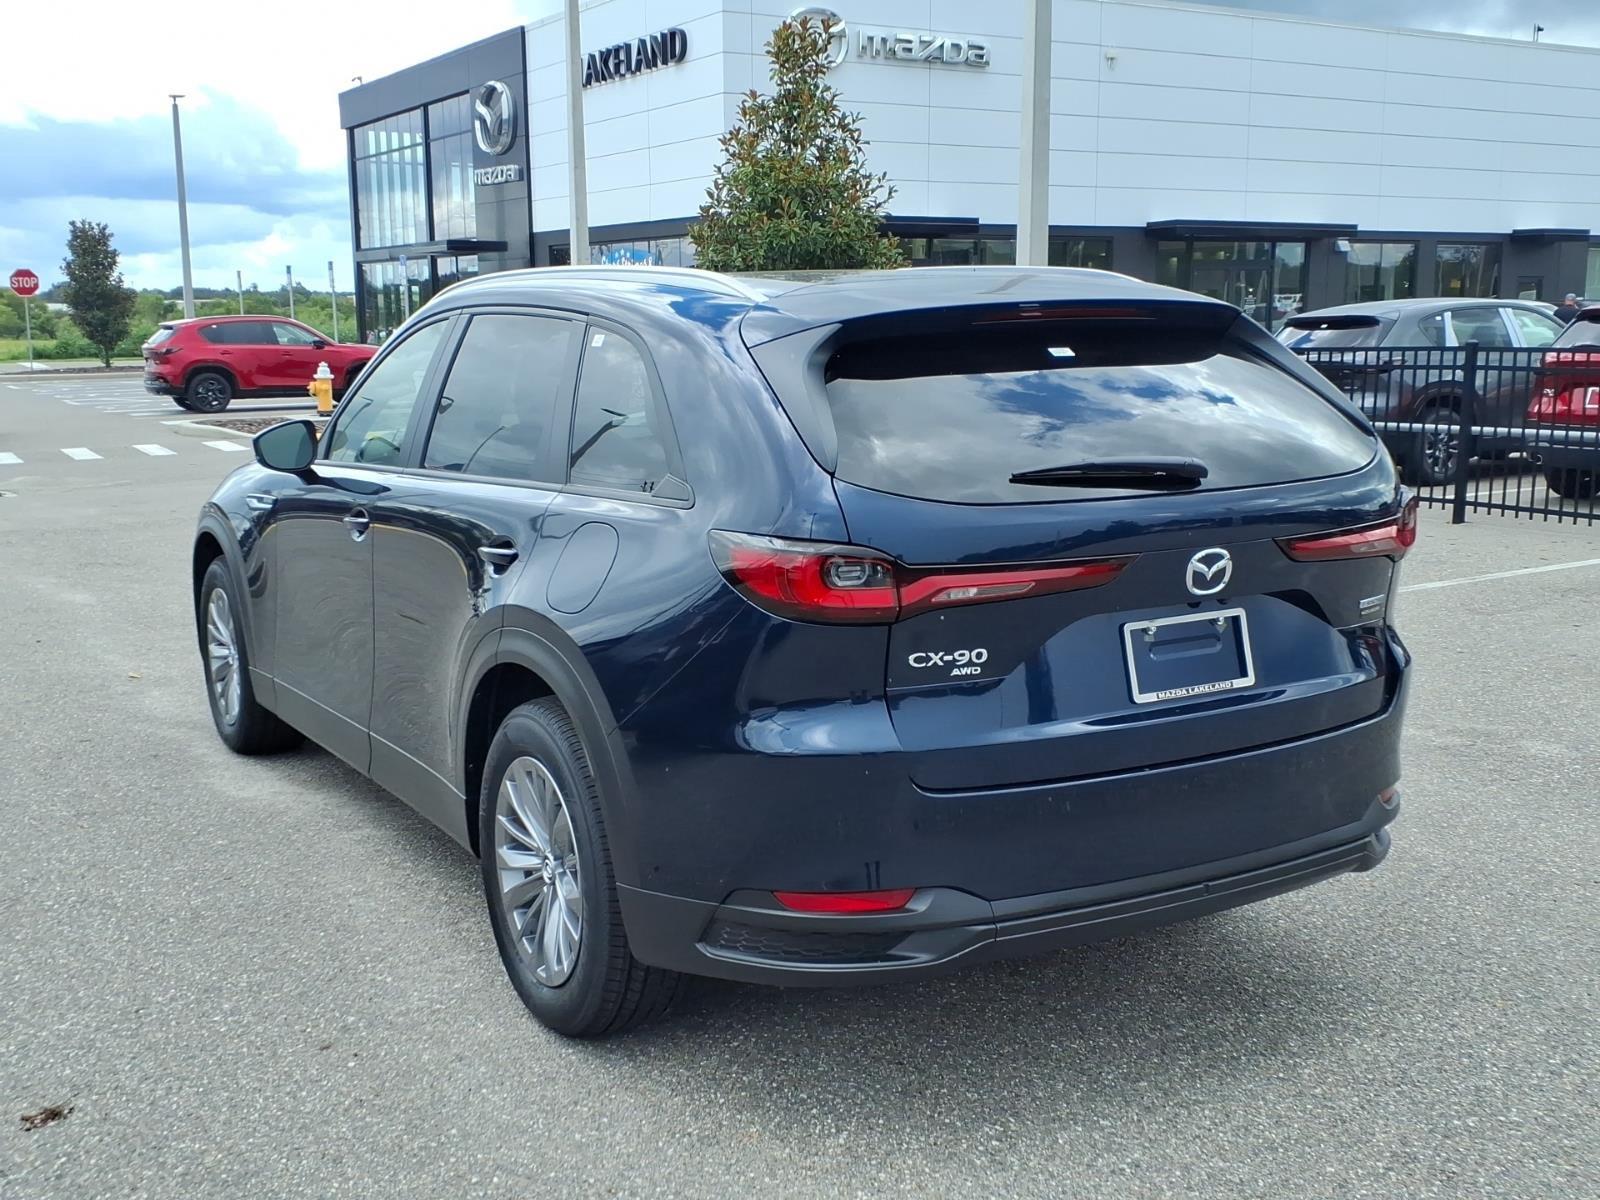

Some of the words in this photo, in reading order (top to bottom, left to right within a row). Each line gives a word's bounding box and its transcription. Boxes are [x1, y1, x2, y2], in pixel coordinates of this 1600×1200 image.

[580, 27, 688, 88] AKELAND
[857, 29, 991, 67] mazda
[474, 164, 520, 185] mazda
[11, 277, 38, 288] STOP
[908, 648, 988, 668] CX-90
[950, 666, 982, 677] AWD
[1158, 689, 1188, 699] MAZDA
[1188, 682, 1232, 694] LAKELAND
